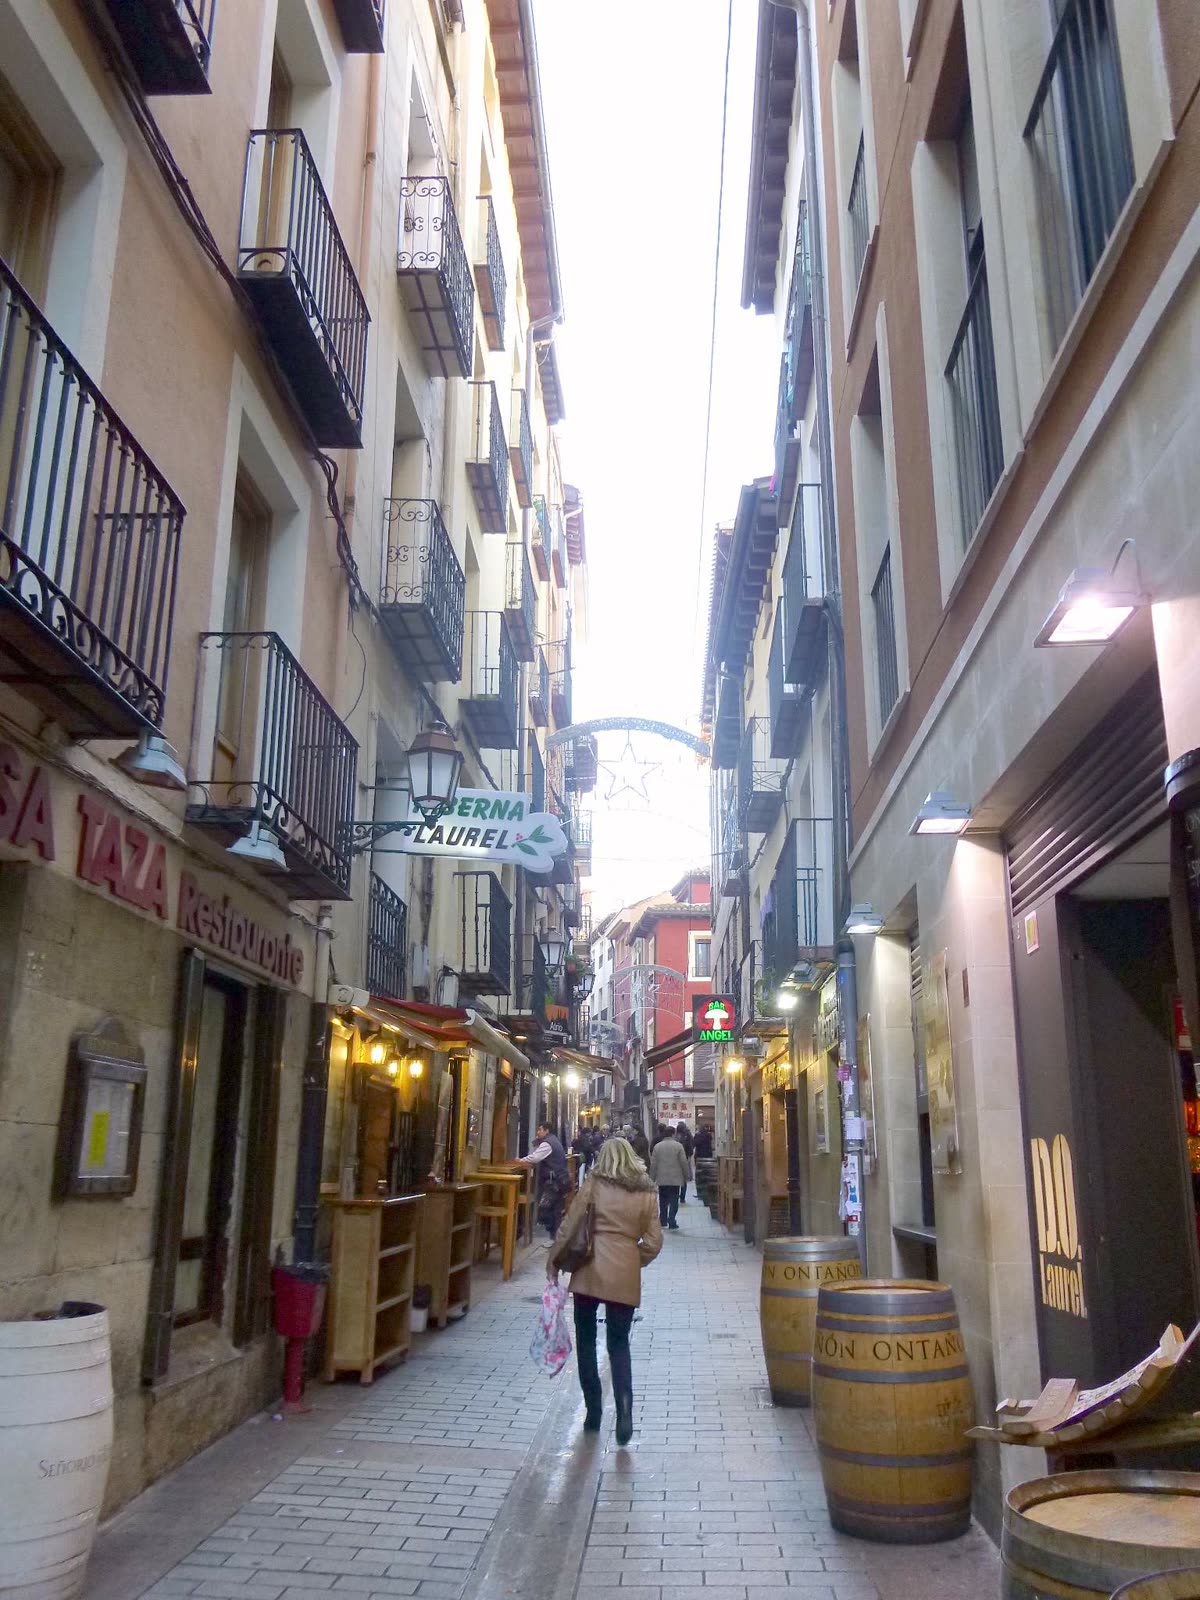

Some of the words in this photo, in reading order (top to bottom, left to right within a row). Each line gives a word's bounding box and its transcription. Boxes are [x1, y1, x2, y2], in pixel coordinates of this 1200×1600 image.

[413, 824, 510, 850] LAUREL
[77, 794, 169, 920] TAZA
[177, 870, 304, 985] Restaurante
[708, 1001, 725, 1011] BAR
[700, 1030, 735, 1041] ANGEL
